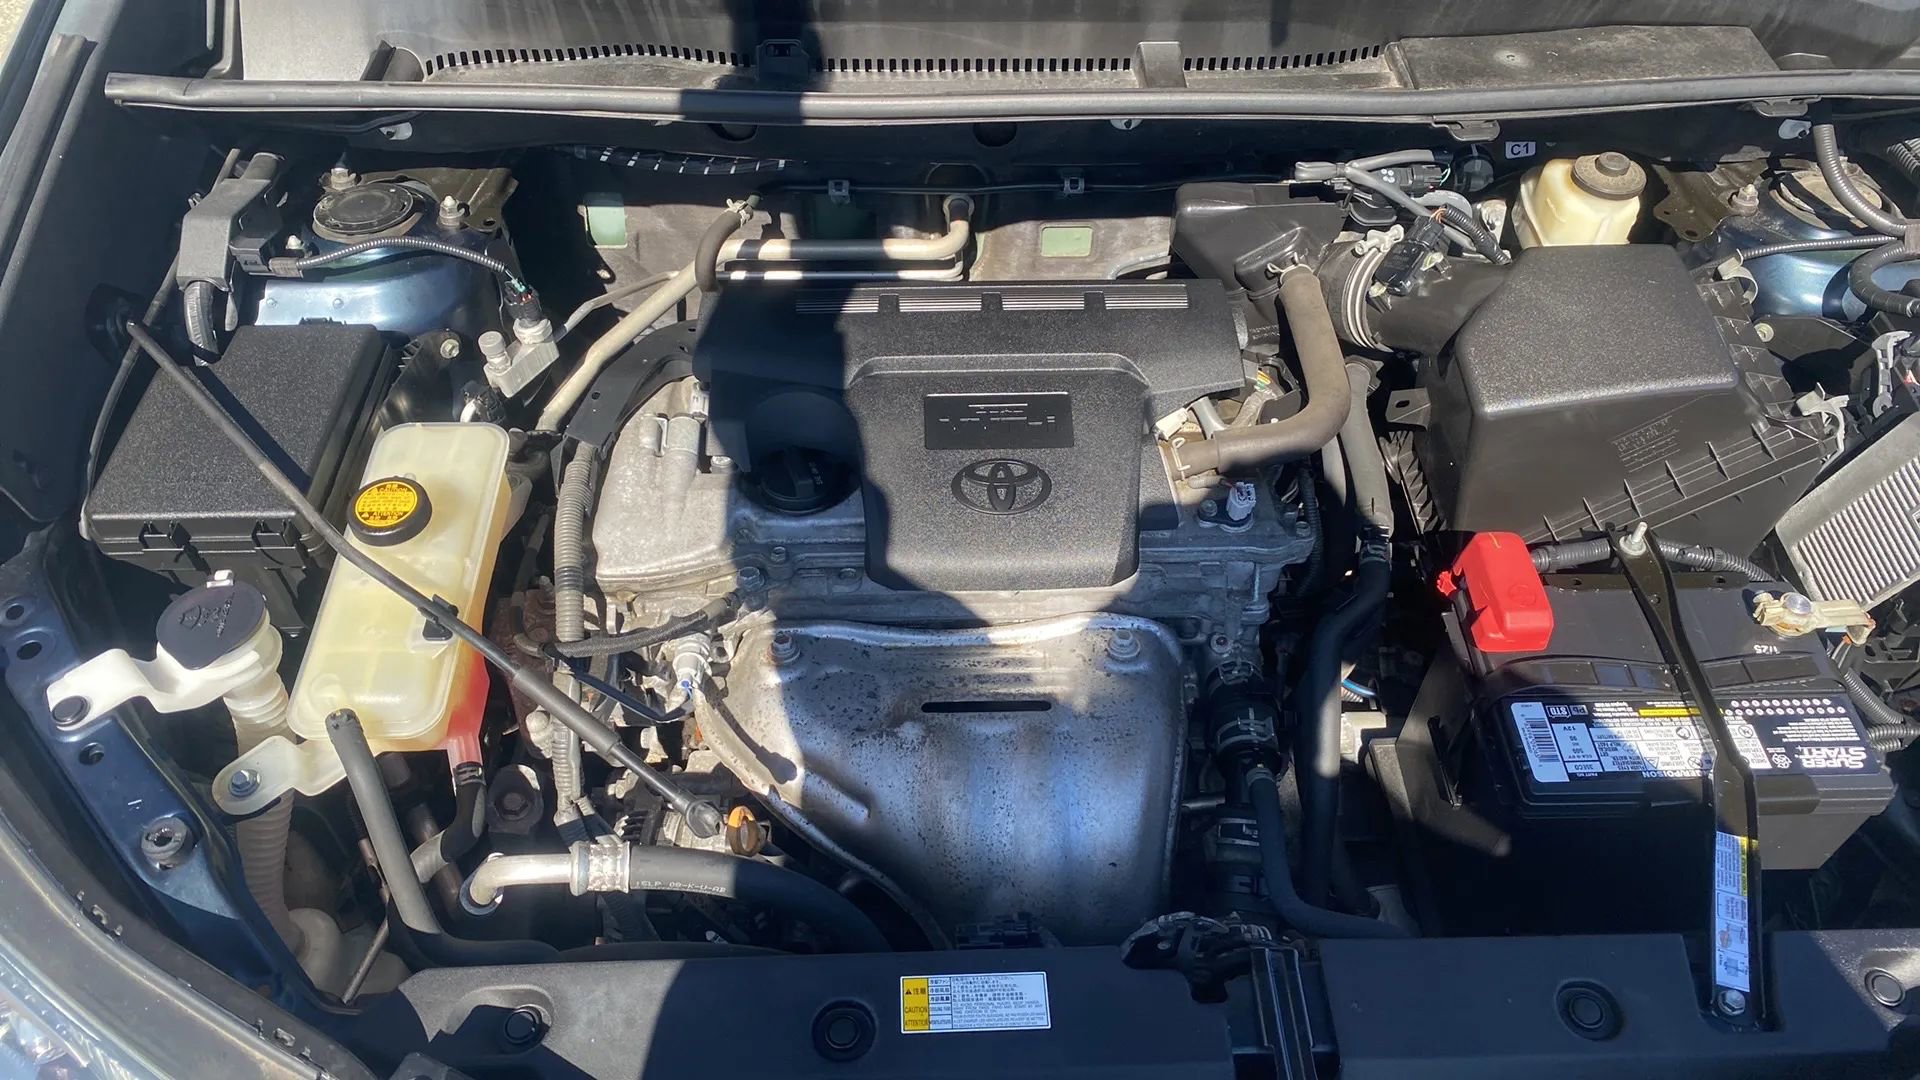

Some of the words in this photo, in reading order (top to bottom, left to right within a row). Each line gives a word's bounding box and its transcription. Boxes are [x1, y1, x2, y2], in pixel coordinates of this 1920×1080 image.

[1510, 143, 1529, 155] C1
[1799, 746, 1867, 759] START
[1801, 757, 1864, 769] SUPER
[904, 1006, 928, 1014] CAUTION
